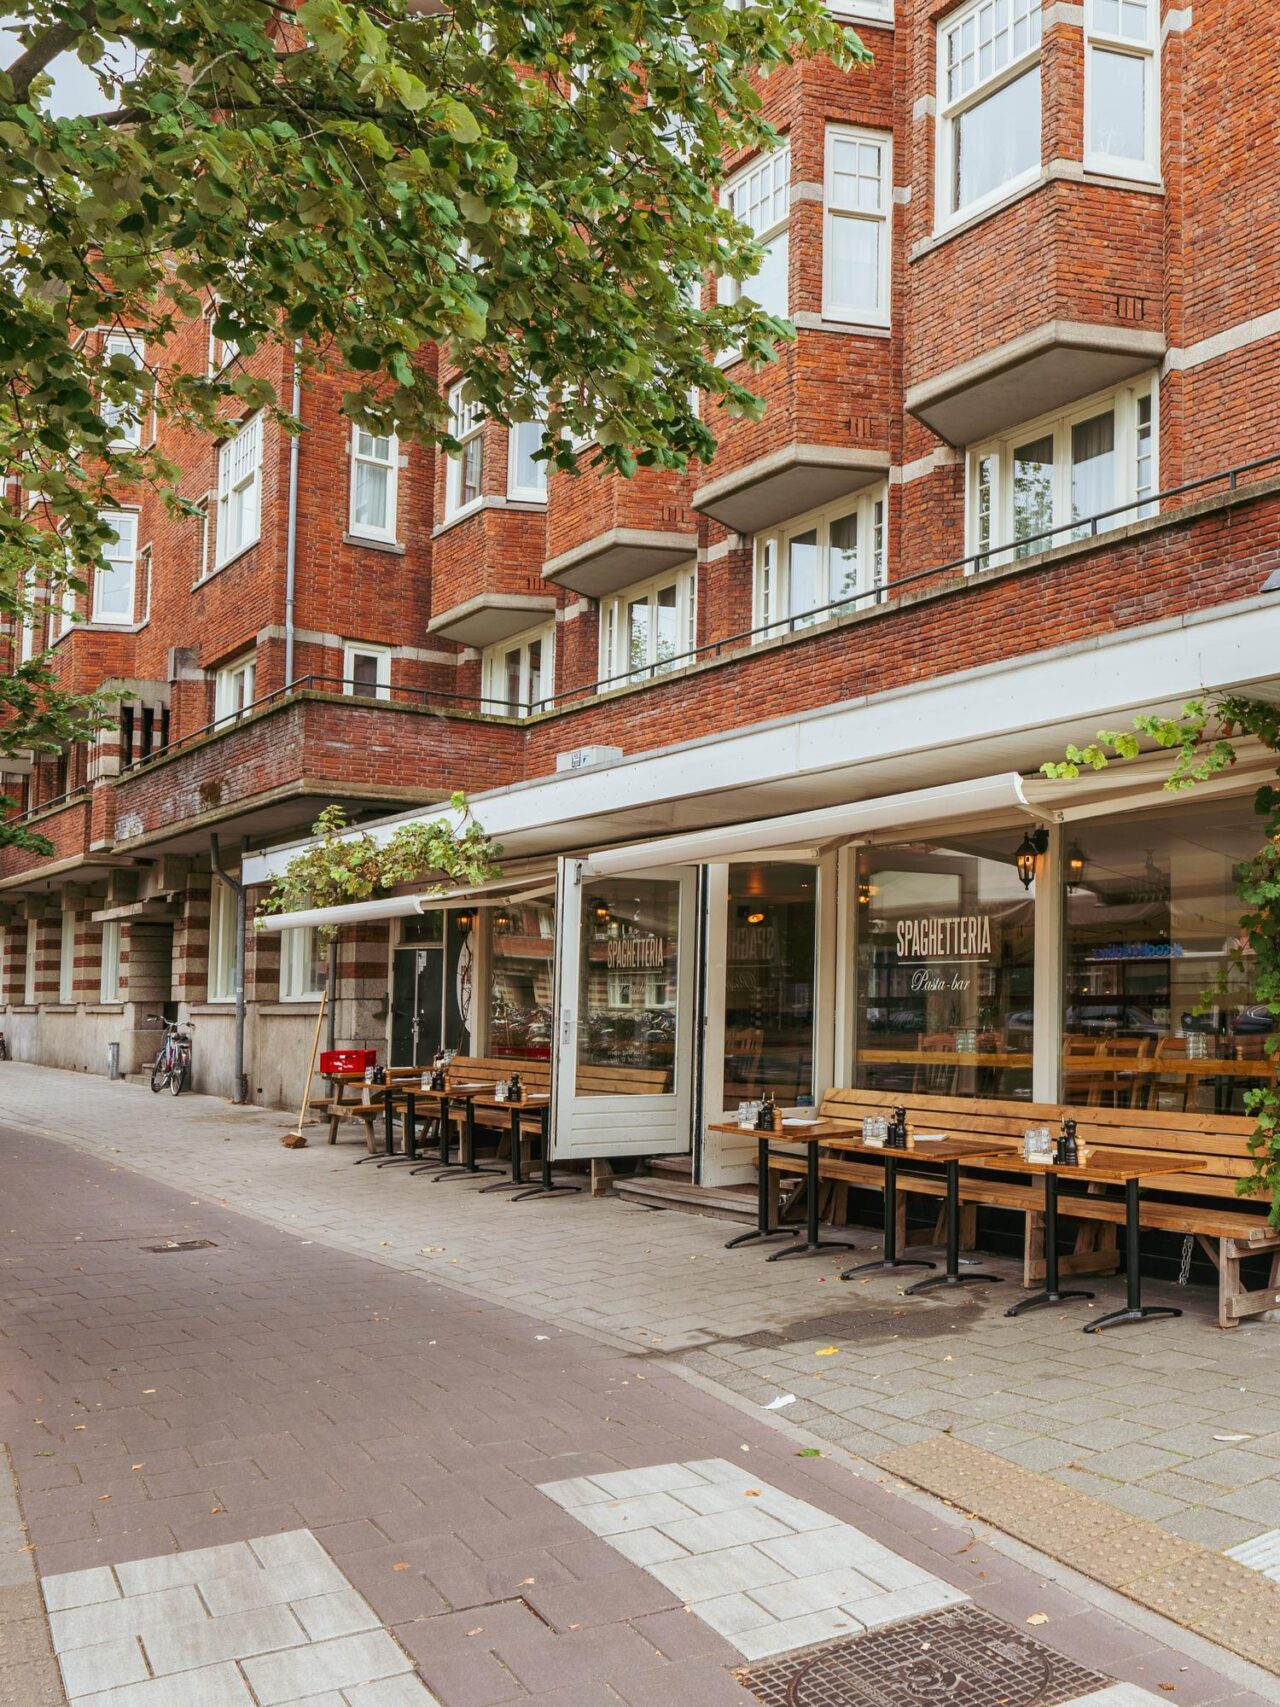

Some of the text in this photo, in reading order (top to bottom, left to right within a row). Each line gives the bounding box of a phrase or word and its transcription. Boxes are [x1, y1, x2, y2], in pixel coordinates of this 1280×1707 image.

[897, 916, 991, 957] SPAGHETTERIA
[607, 938, 664, 968] SPAGHETTERIA
[911, 969, 970, 991] Pasta-bar
